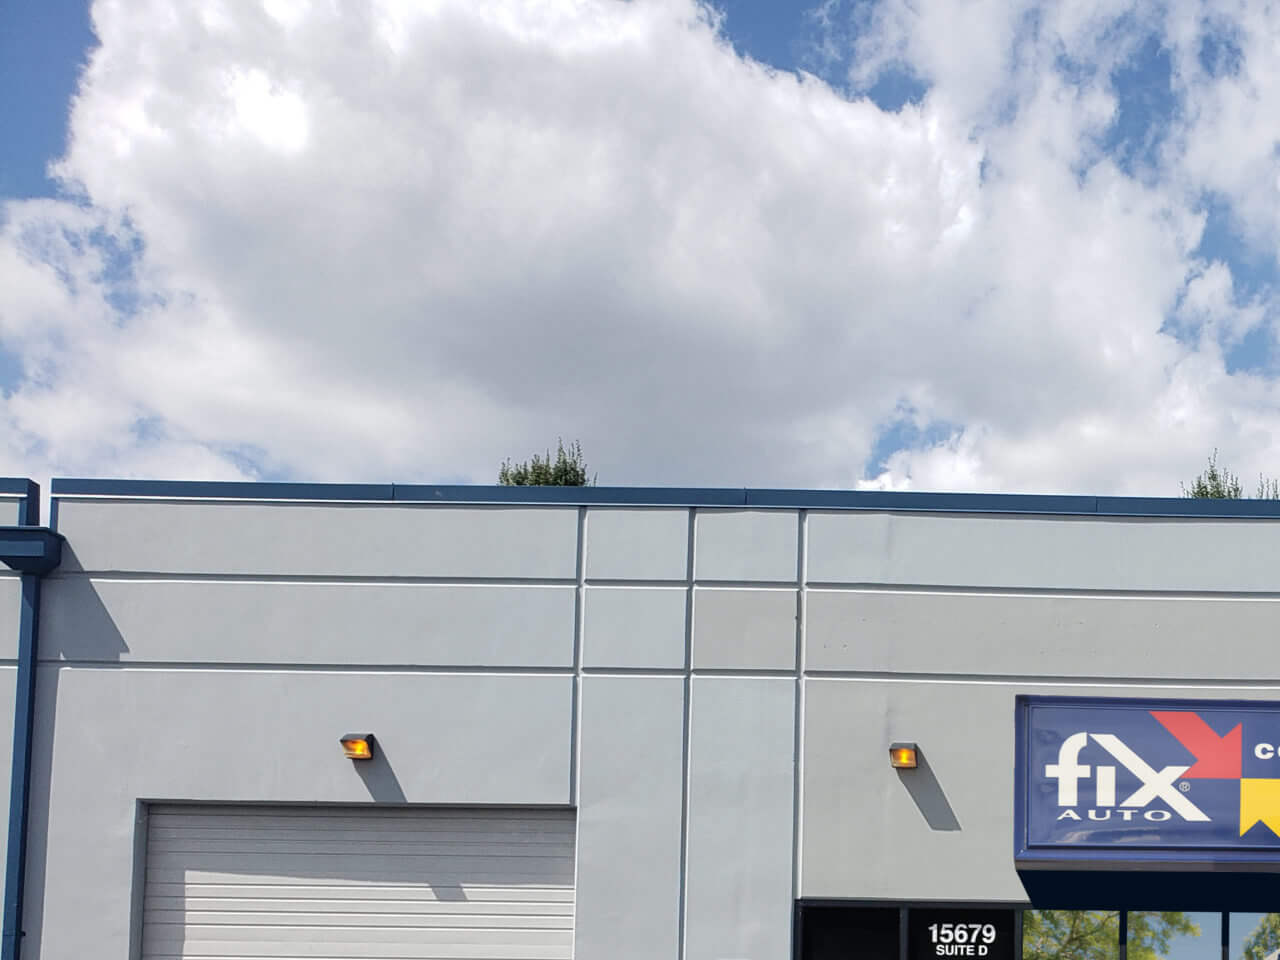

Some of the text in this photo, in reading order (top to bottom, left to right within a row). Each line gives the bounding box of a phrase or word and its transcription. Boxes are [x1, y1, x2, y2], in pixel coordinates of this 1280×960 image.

[1056, 809, 1173, 822] AUTO
[928, 923, 996, 944] 15679
[935, 944, 988, 956] SUITE D
